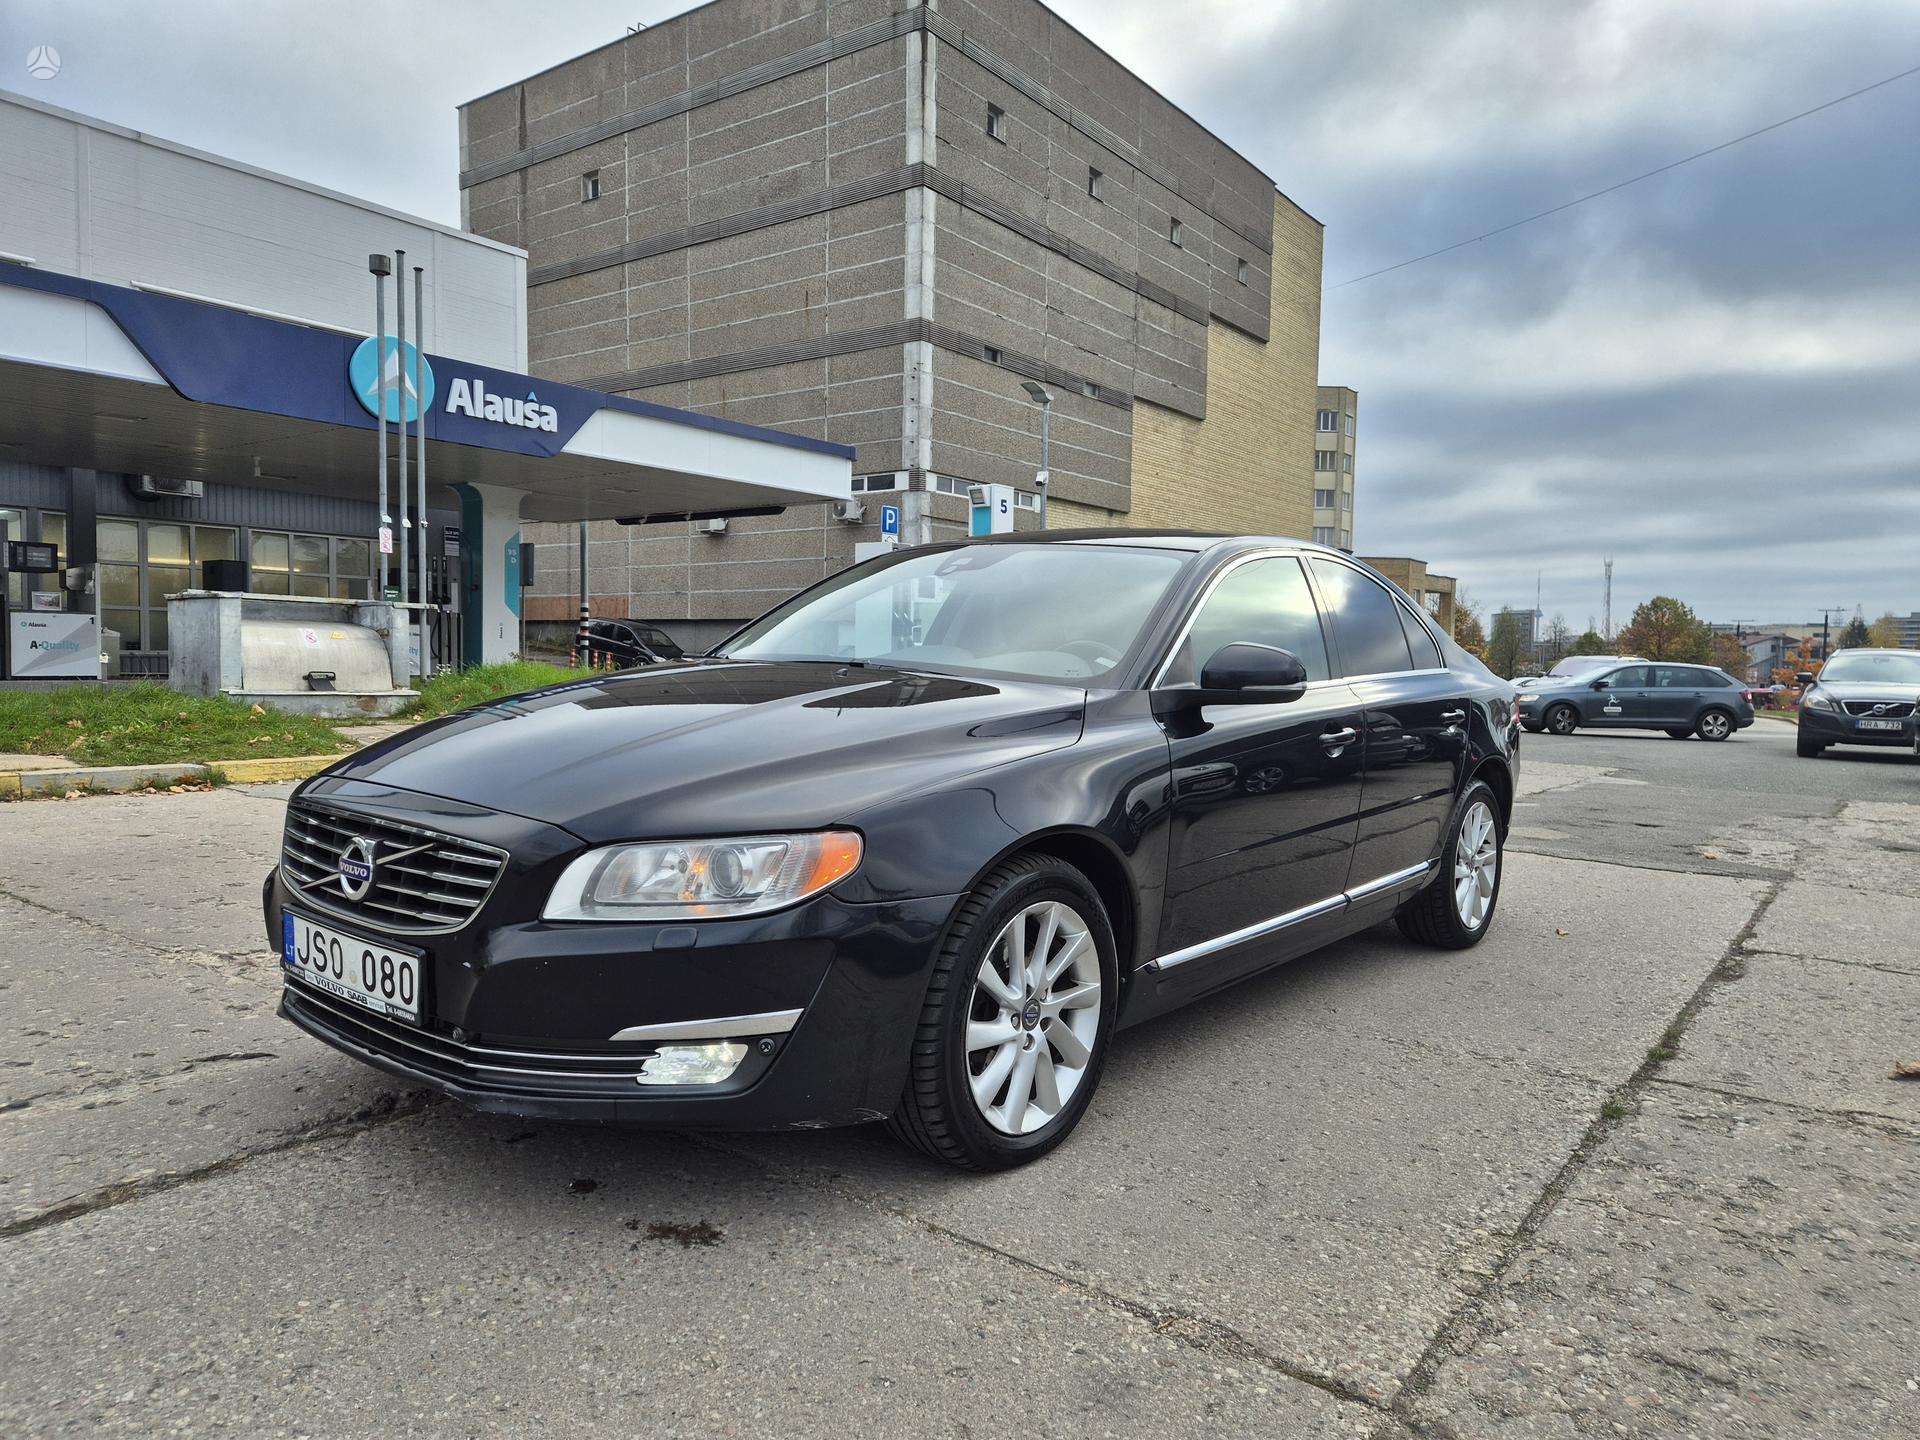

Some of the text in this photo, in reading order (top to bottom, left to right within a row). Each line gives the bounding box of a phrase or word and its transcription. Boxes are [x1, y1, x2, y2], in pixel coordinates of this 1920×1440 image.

[1000, 499, 1008, 514] 5
[886, 509, 896, 531] P
[89, 617, 95, 625] 1
[29, 640, 80, 651] A-Quality
[340, 861, 368, 877] VOLVO
[285, 943, 294, 957] LT
[297, 926, 414, 1006] JSO 080
[314, 975, 345, 996] VOLVO
[346, 990, 368, 1005] SAAB
